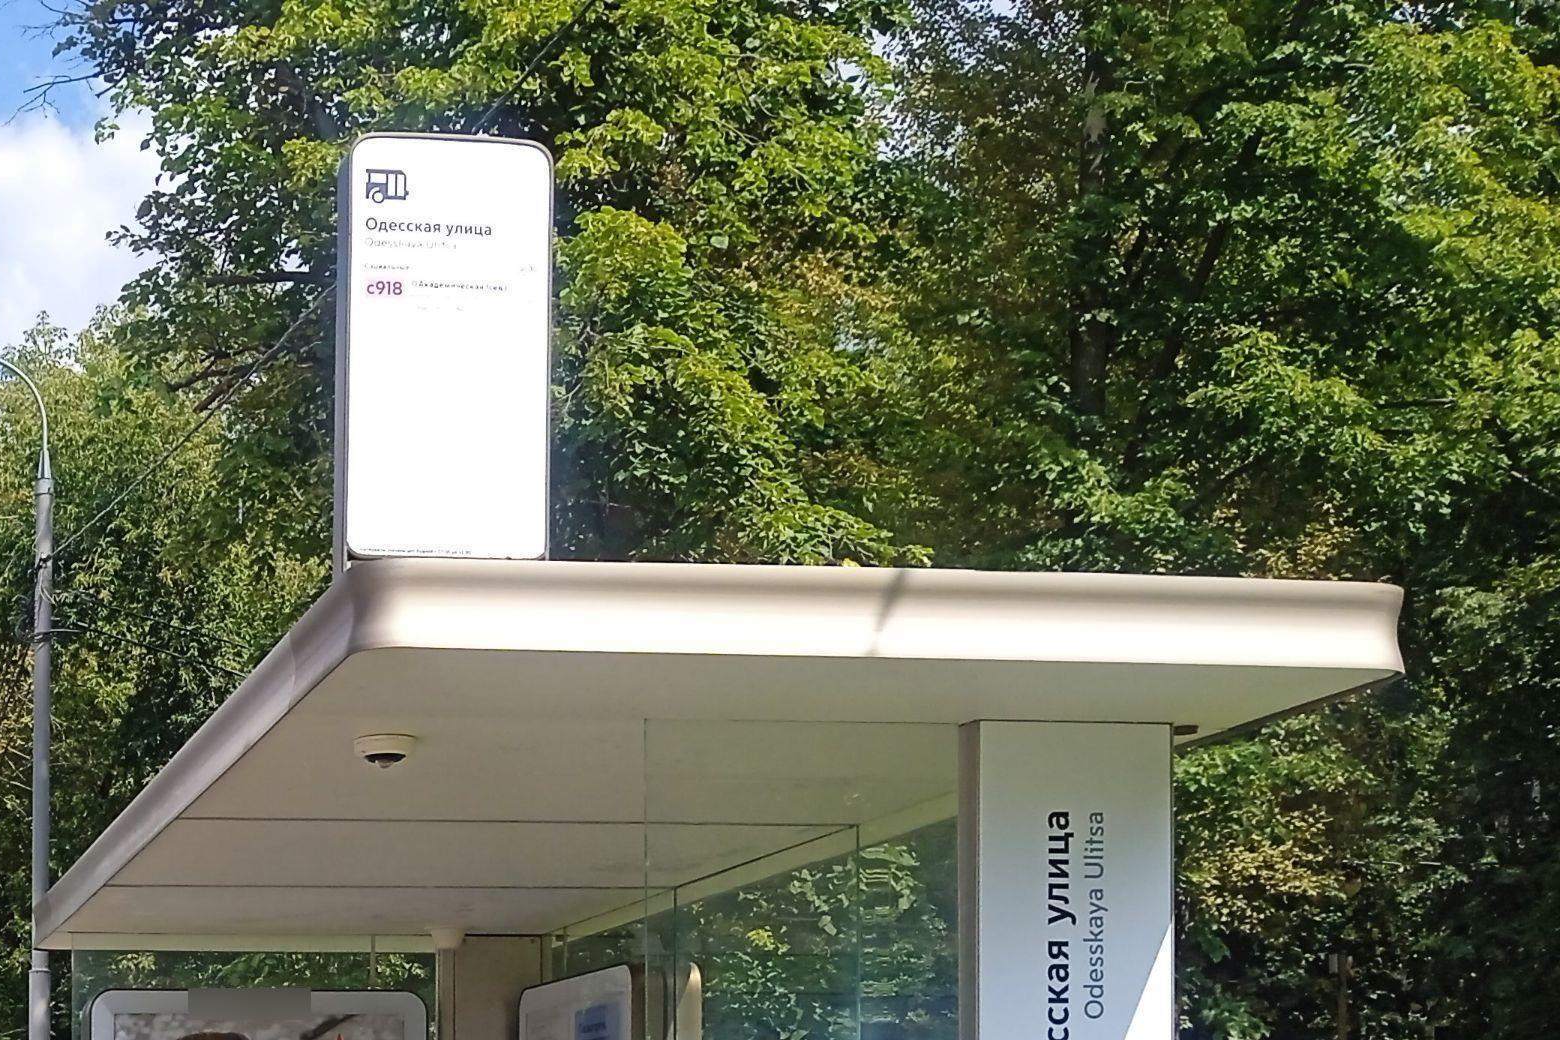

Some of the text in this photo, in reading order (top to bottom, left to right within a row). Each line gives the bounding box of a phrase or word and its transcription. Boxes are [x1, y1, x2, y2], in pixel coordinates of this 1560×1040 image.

[365, 217, 492, 237] Одесская улица
[366, 280, 403, 296] с918
[1047, 809, 1077, 925] улица
[1083, 811, 1109, 1019] Odesskaya Ulitsa
